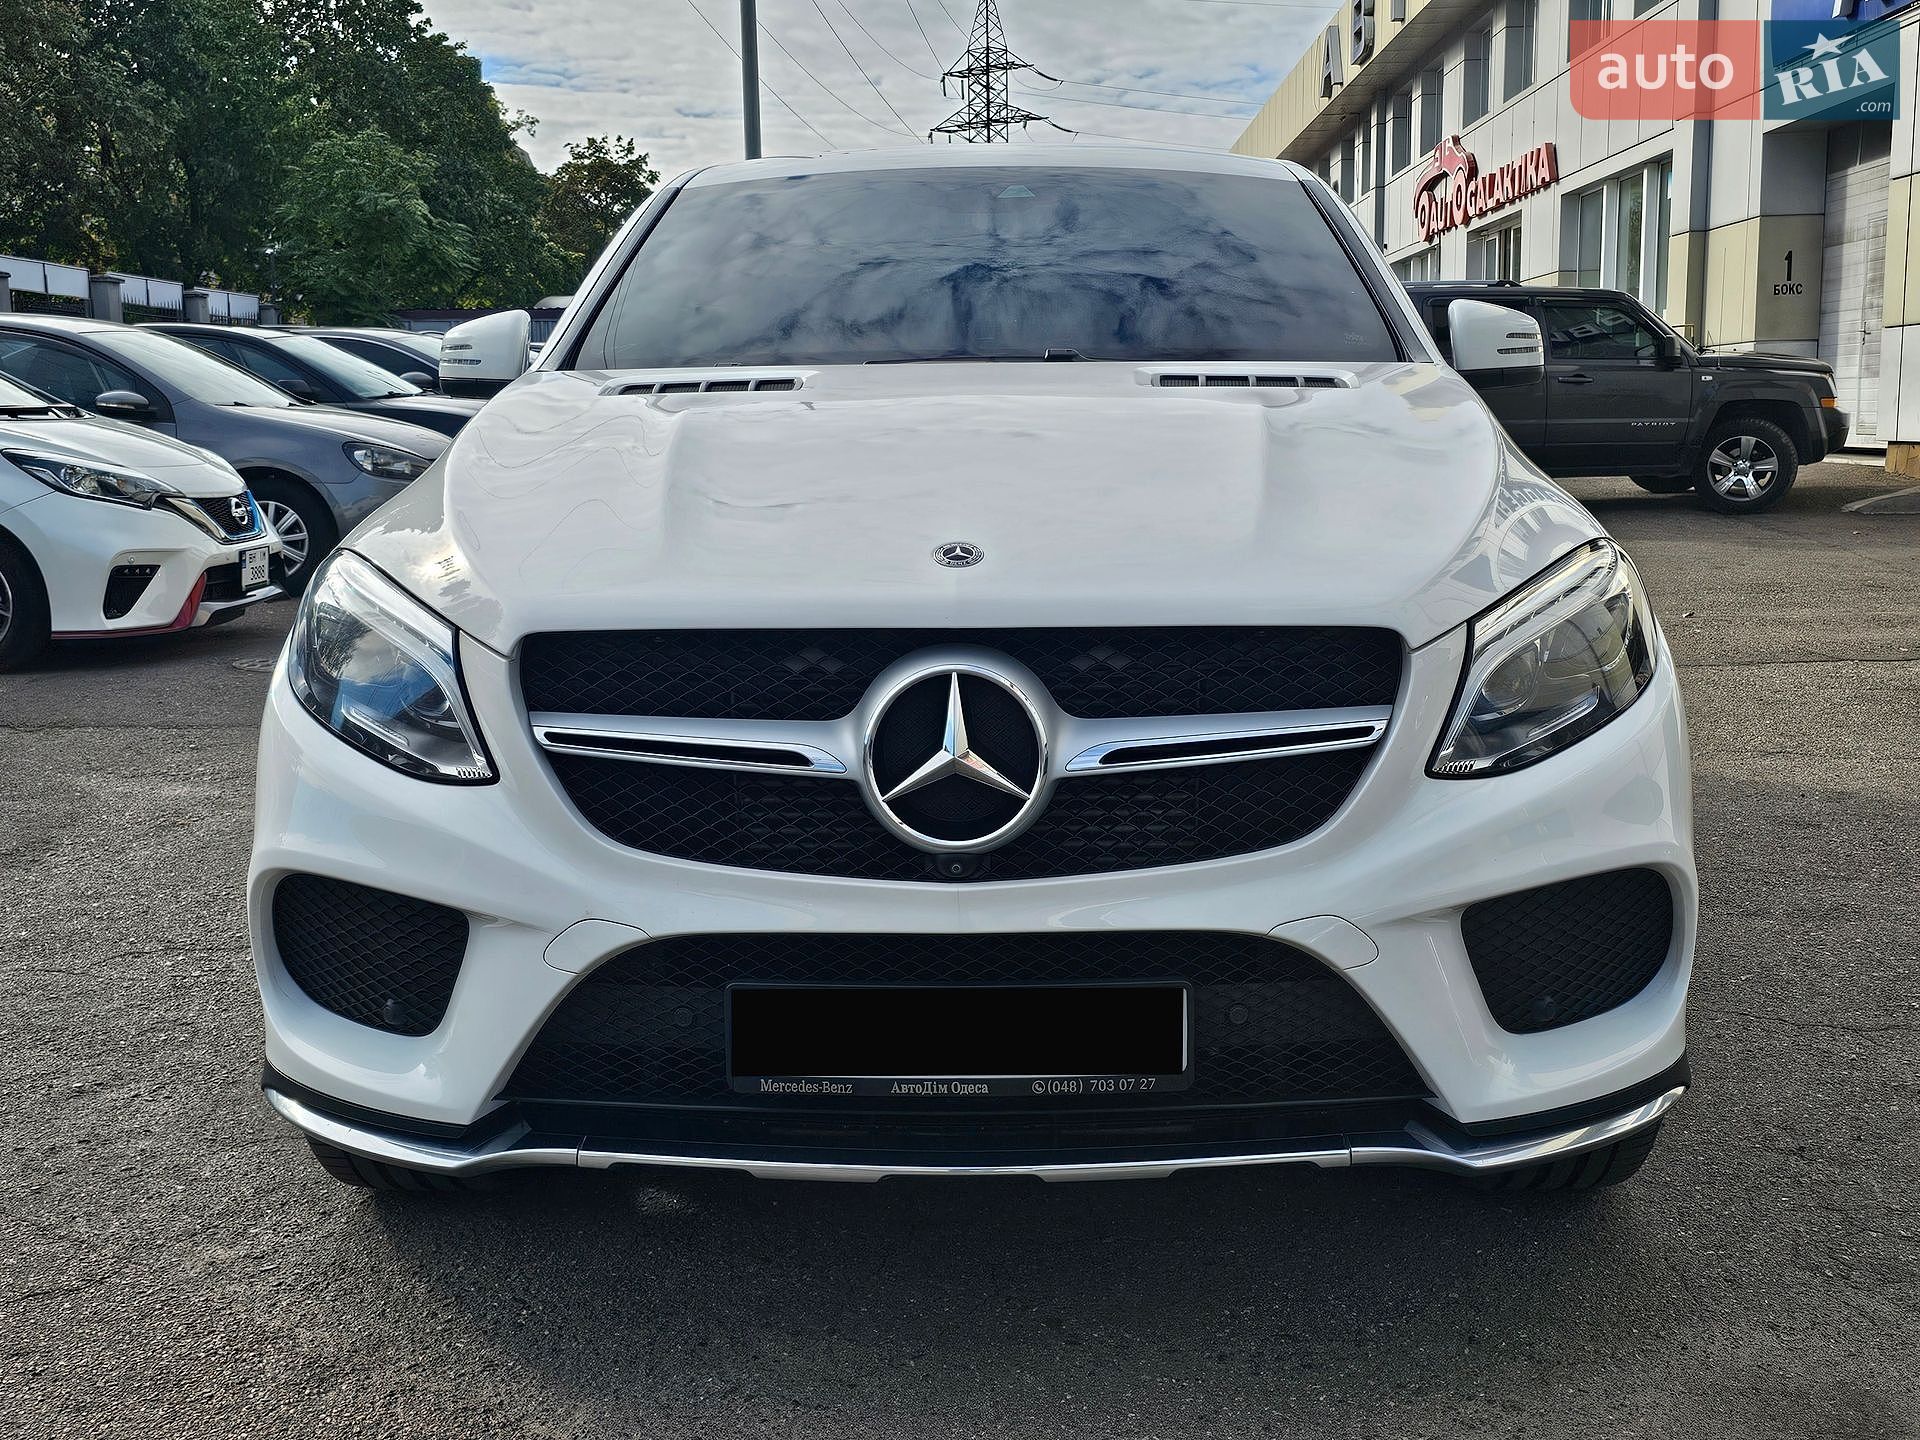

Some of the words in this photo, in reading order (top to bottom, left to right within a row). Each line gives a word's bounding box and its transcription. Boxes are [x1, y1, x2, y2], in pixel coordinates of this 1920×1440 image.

[1784, 250, 1793, 281] 1
[1773, 283, 1803, 296] БОКС
[760, 1078, 853, 1094] Mercedes-Benz
[890, 1080, 948, 1096] АвтоДім
[951, 1080, 989, 1095] Одеса
[1047, 1079, 1083, 1094] (048)
[1090, 1078, 1115, 1092] 703
[1119, 1078, 1135, 1091] 07
[1139, 1077, 1156, 1090] 27
